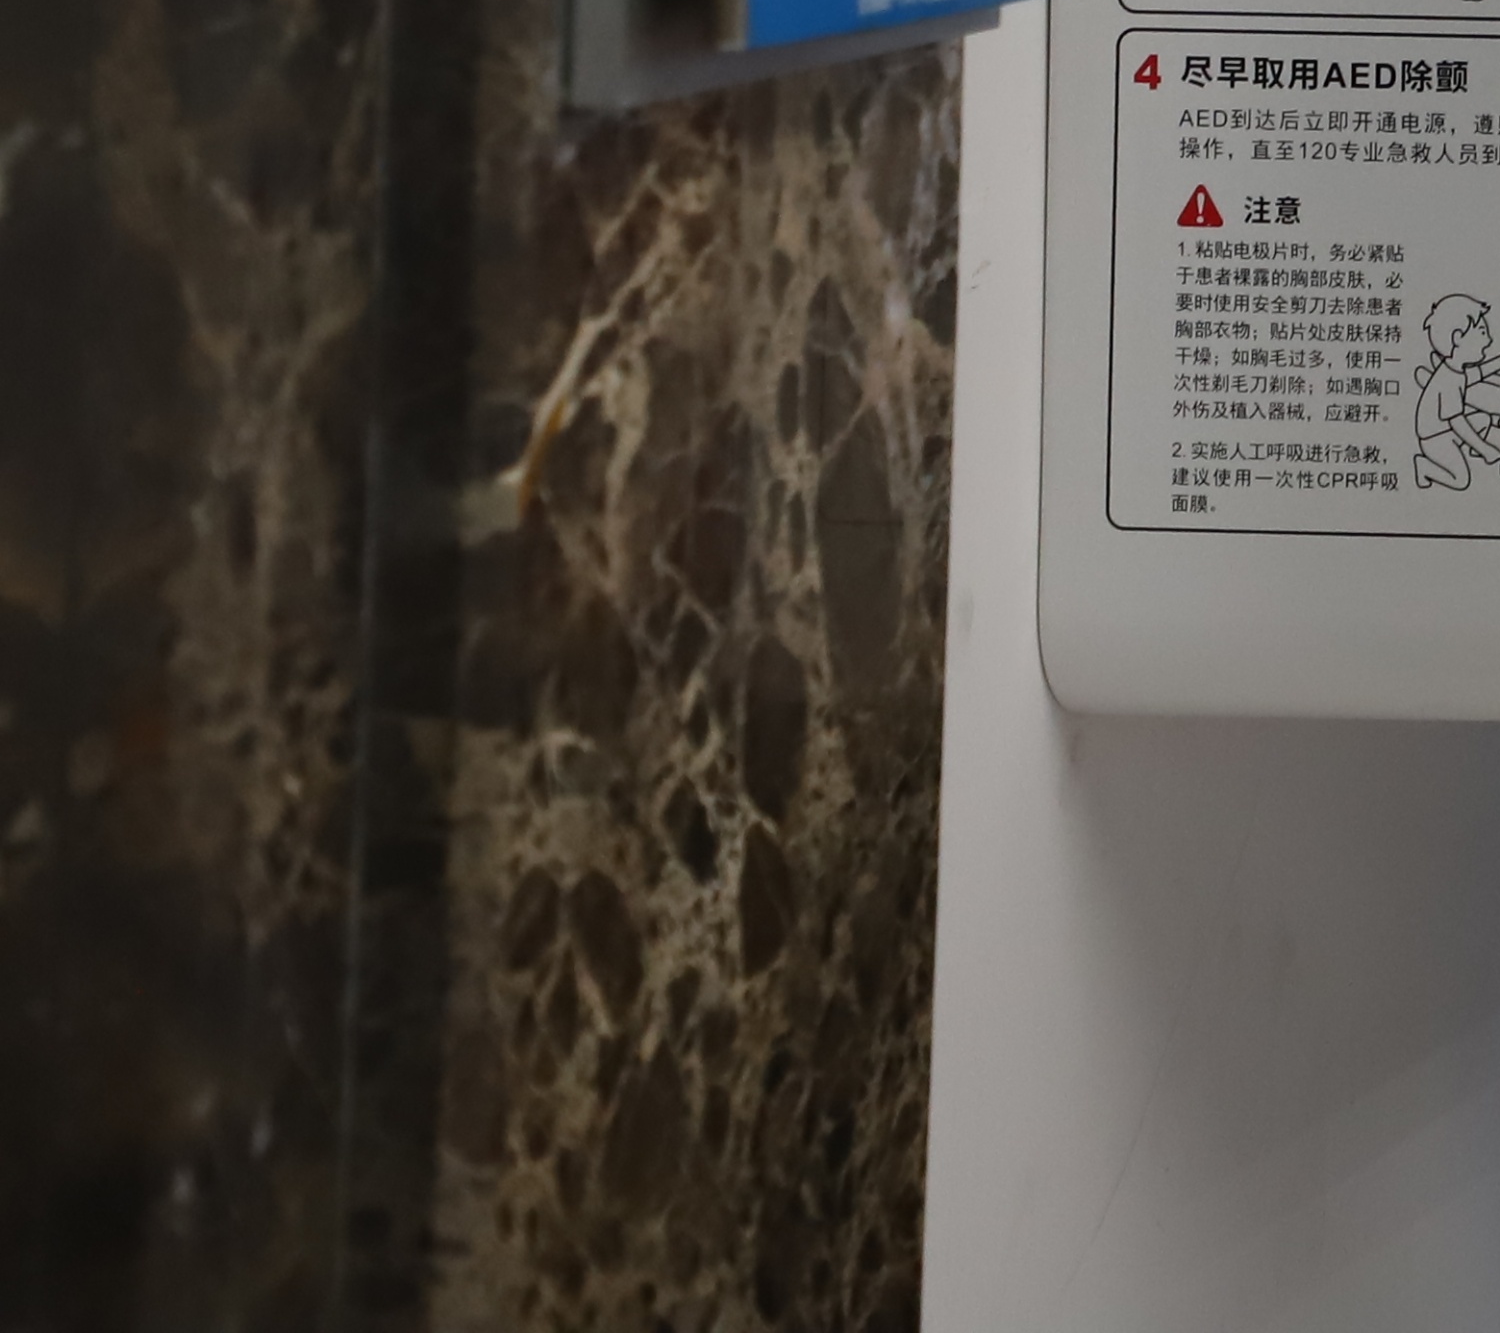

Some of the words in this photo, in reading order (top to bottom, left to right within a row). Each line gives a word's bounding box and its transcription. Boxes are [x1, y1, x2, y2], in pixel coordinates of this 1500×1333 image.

[1134, 54, 1162, 90] 4
[1181, 56, 1468, 94] 尽早取用AED除颤
[1244, 196, 1301, 225] 注意
[1176, 293, 1403, 316] 要时使用安全剪刀去除患者
[1172, 467, 1398, 491] 建议使用一次性CPR呼吸
